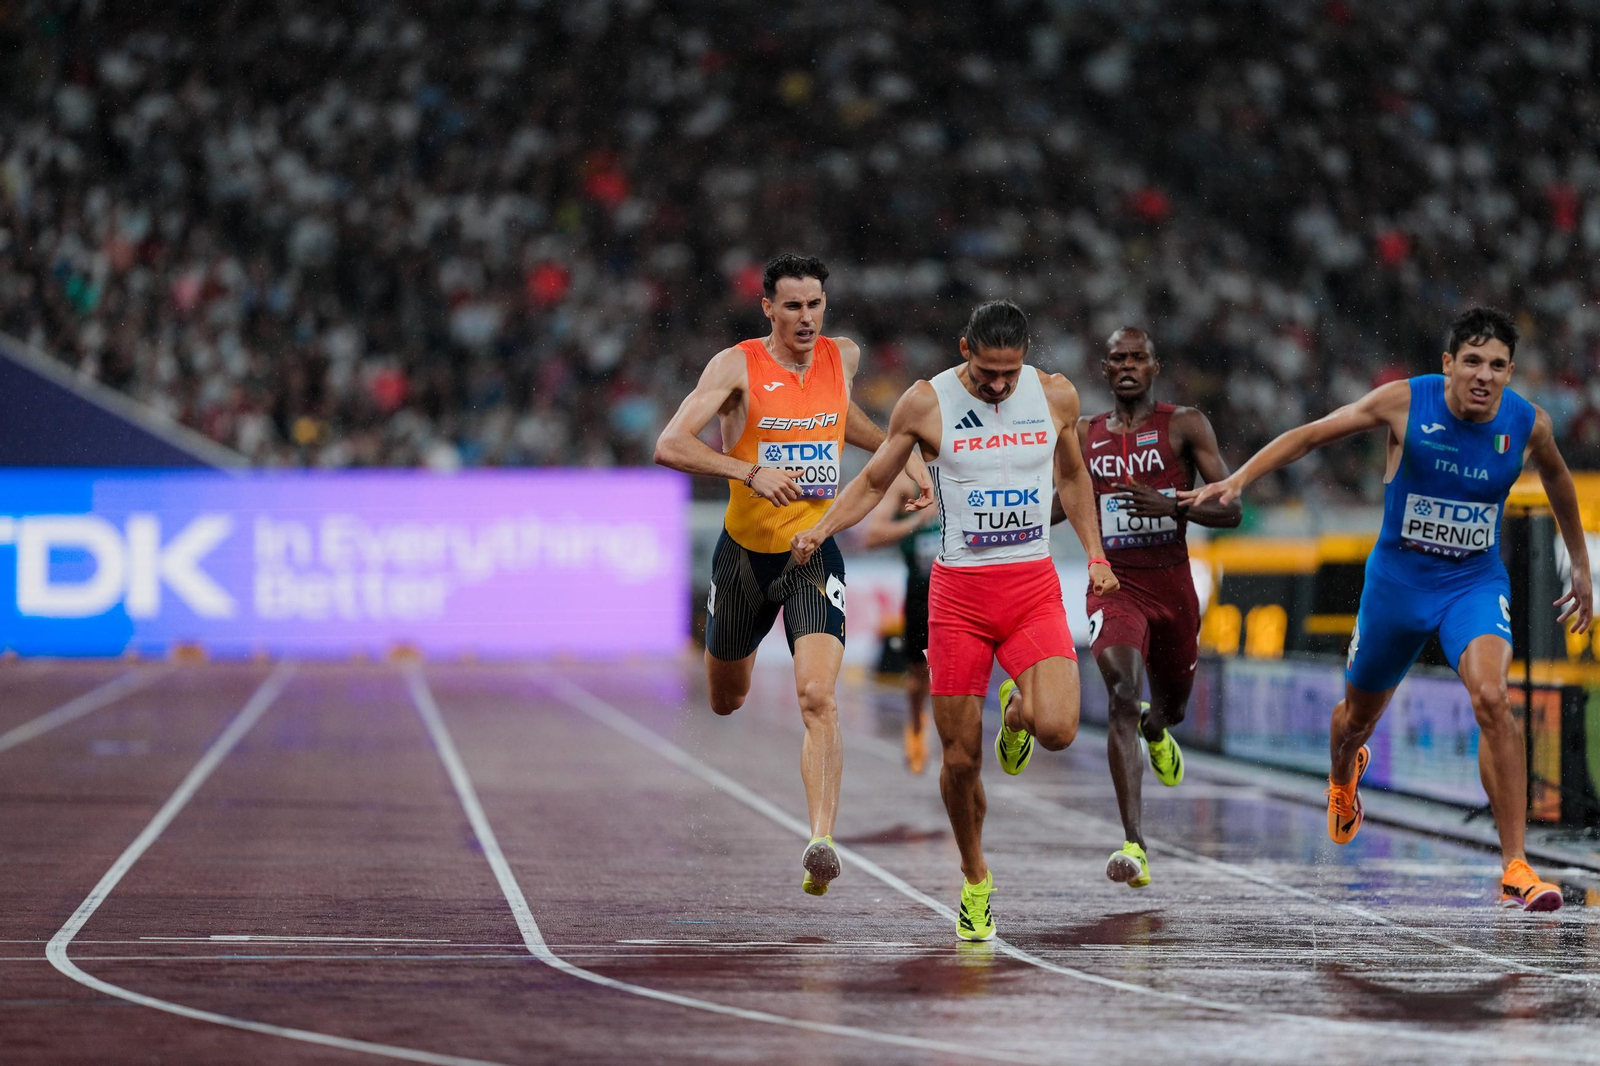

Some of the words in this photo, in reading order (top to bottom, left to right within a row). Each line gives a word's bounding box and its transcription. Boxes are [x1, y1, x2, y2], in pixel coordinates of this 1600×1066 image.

[757, 412, 838, 430] ESPAÑA
[782, 443, 833, 461] TDK
[953, 431, 1048, 453] FRANCE
[1090, 449, 1165, 477] KENYA
[984, 488, 1040, 508] TDK
[974, 510, 1033, 530] TUAL
[1433, 501, 1492, 524] TDK
[1028, 528, 1040, 539] 25
[1408, 519, 1490, 547] PERNICI
